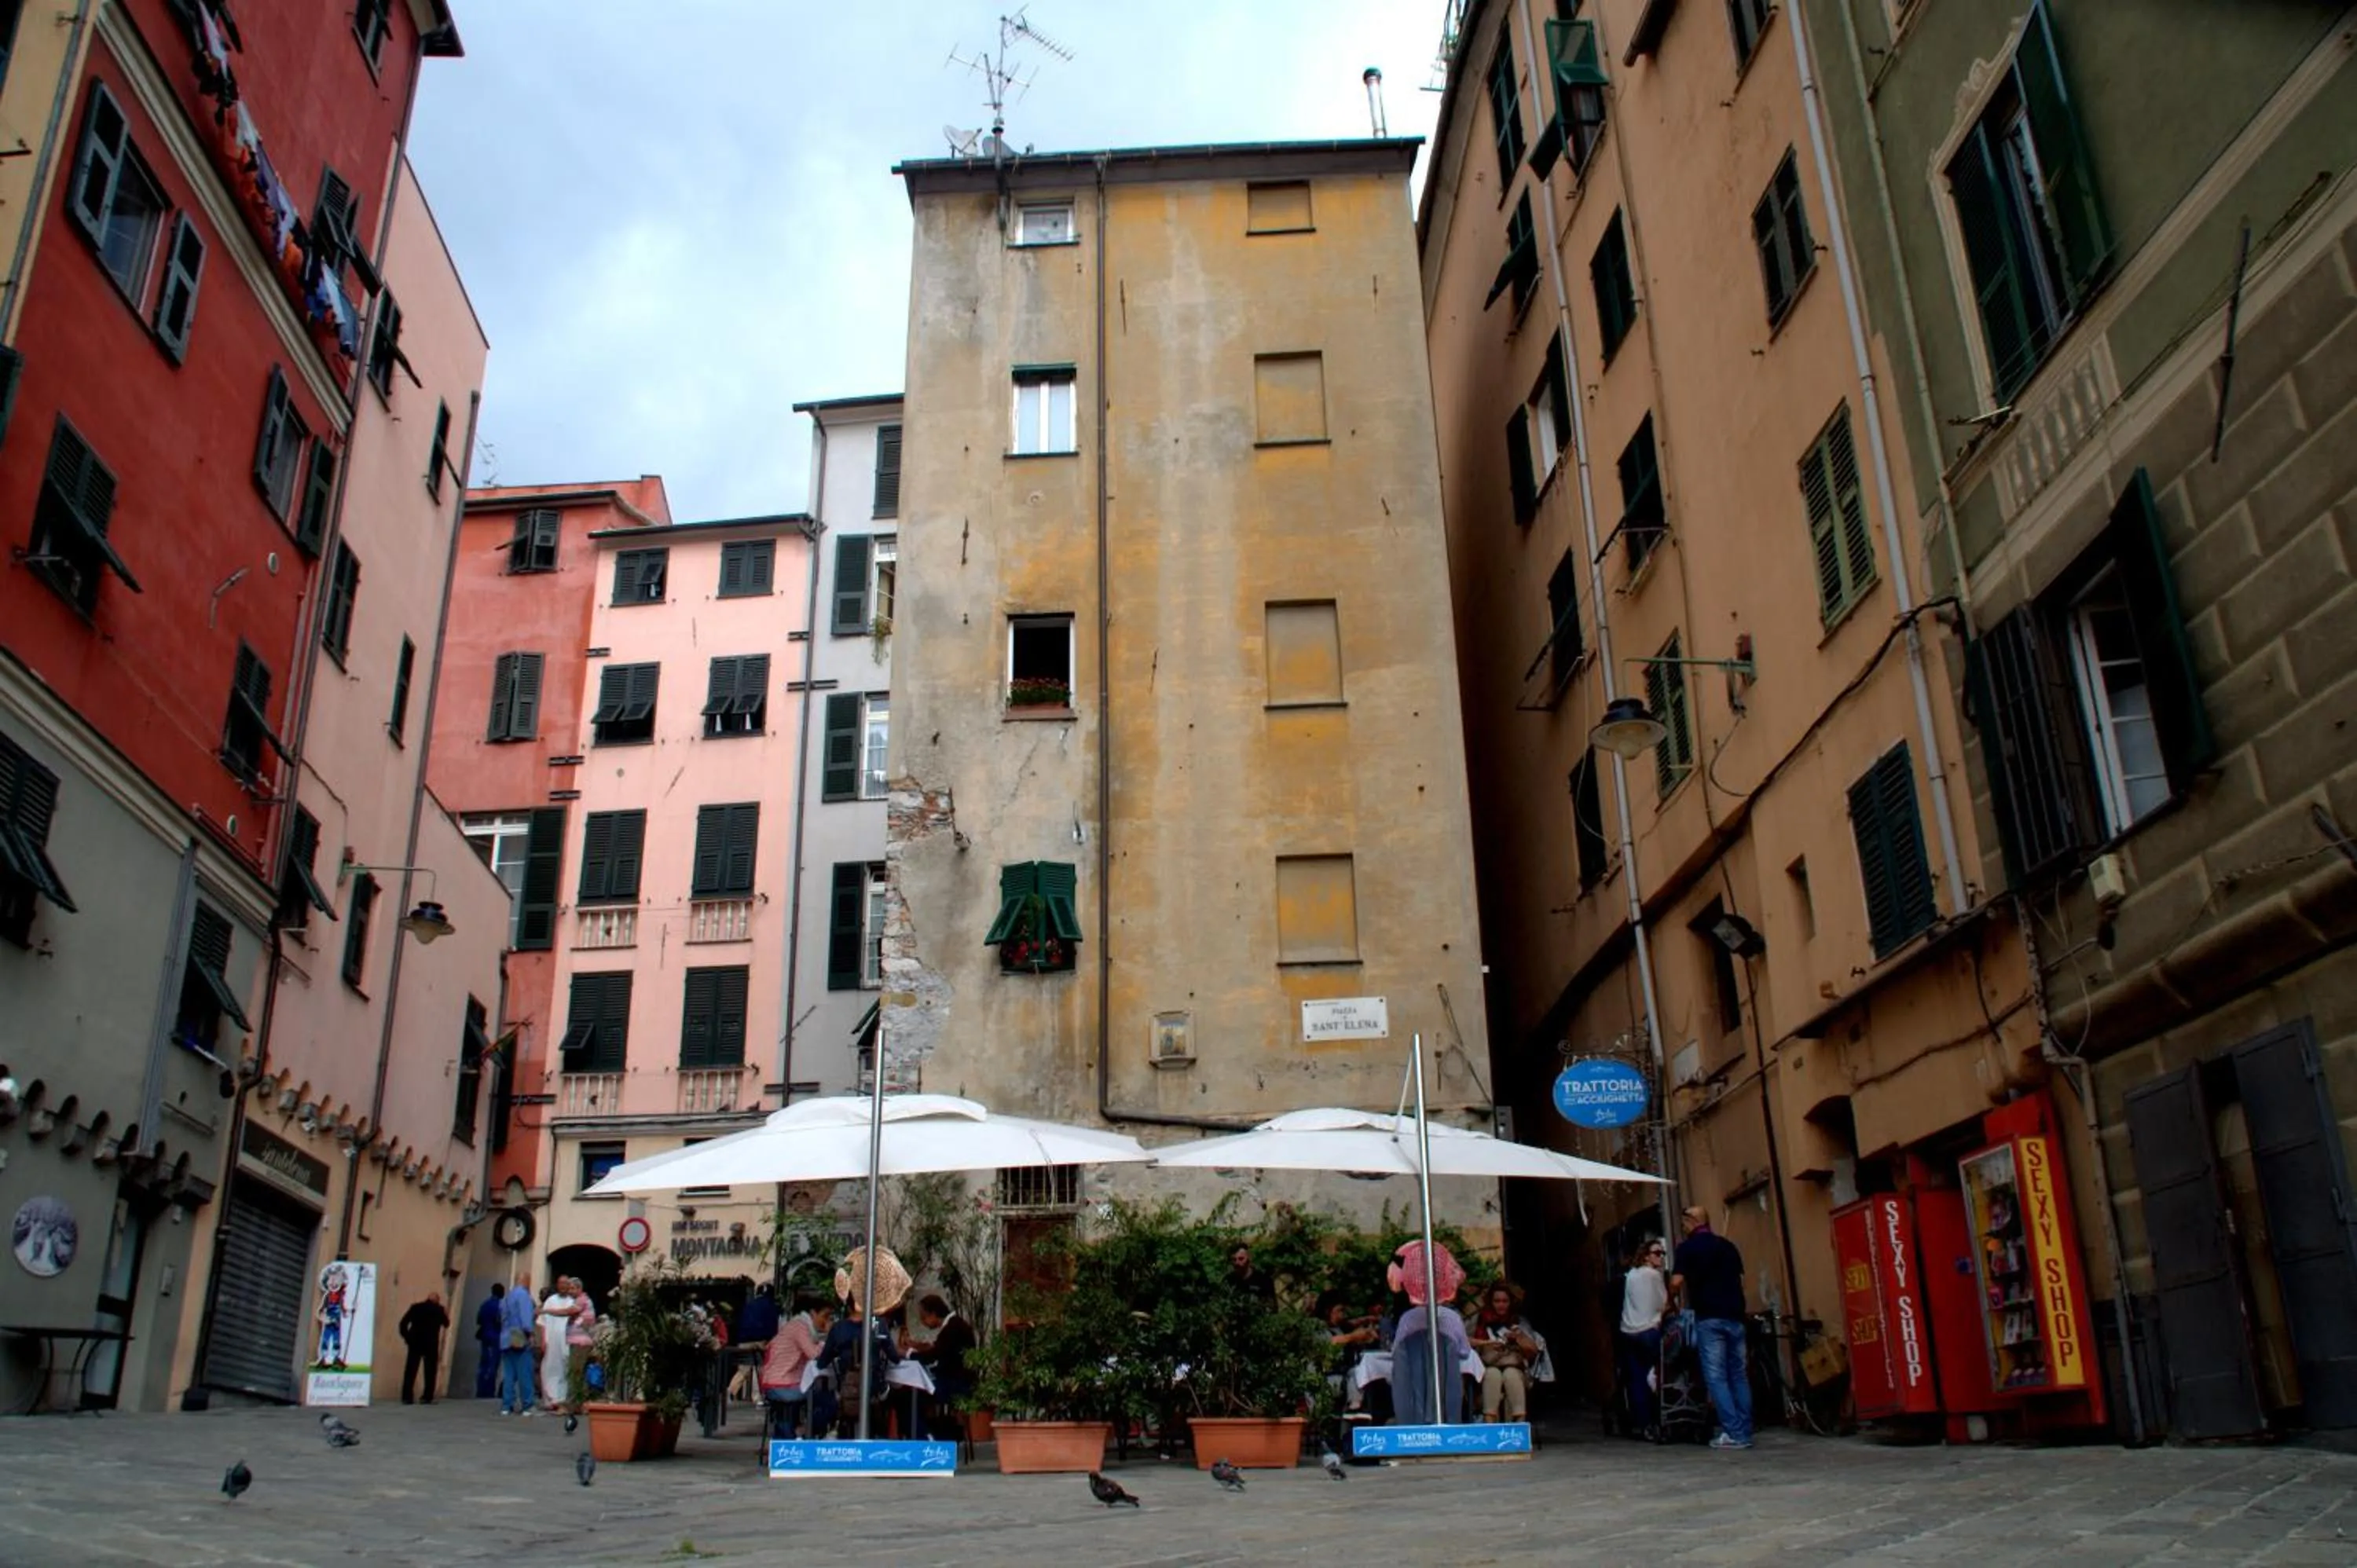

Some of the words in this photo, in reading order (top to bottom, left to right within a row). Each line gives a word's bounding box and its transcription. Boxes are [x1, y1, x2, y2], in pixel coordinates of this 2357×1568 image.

[1561, 1079, 1644, 1094] TRATTORIA
[672, 1235, 761, 1259] MONTAGNA
[2025, 1141, 2051, 1246] SEXY
[2045, 1258, 2074, 1367] SHOP
[1885, 1200, 1906, 1288] SEXY
[1898, 1295, 1923, 1387] SHOP
[816, 1446, 863, 1456] TRATTORIA
